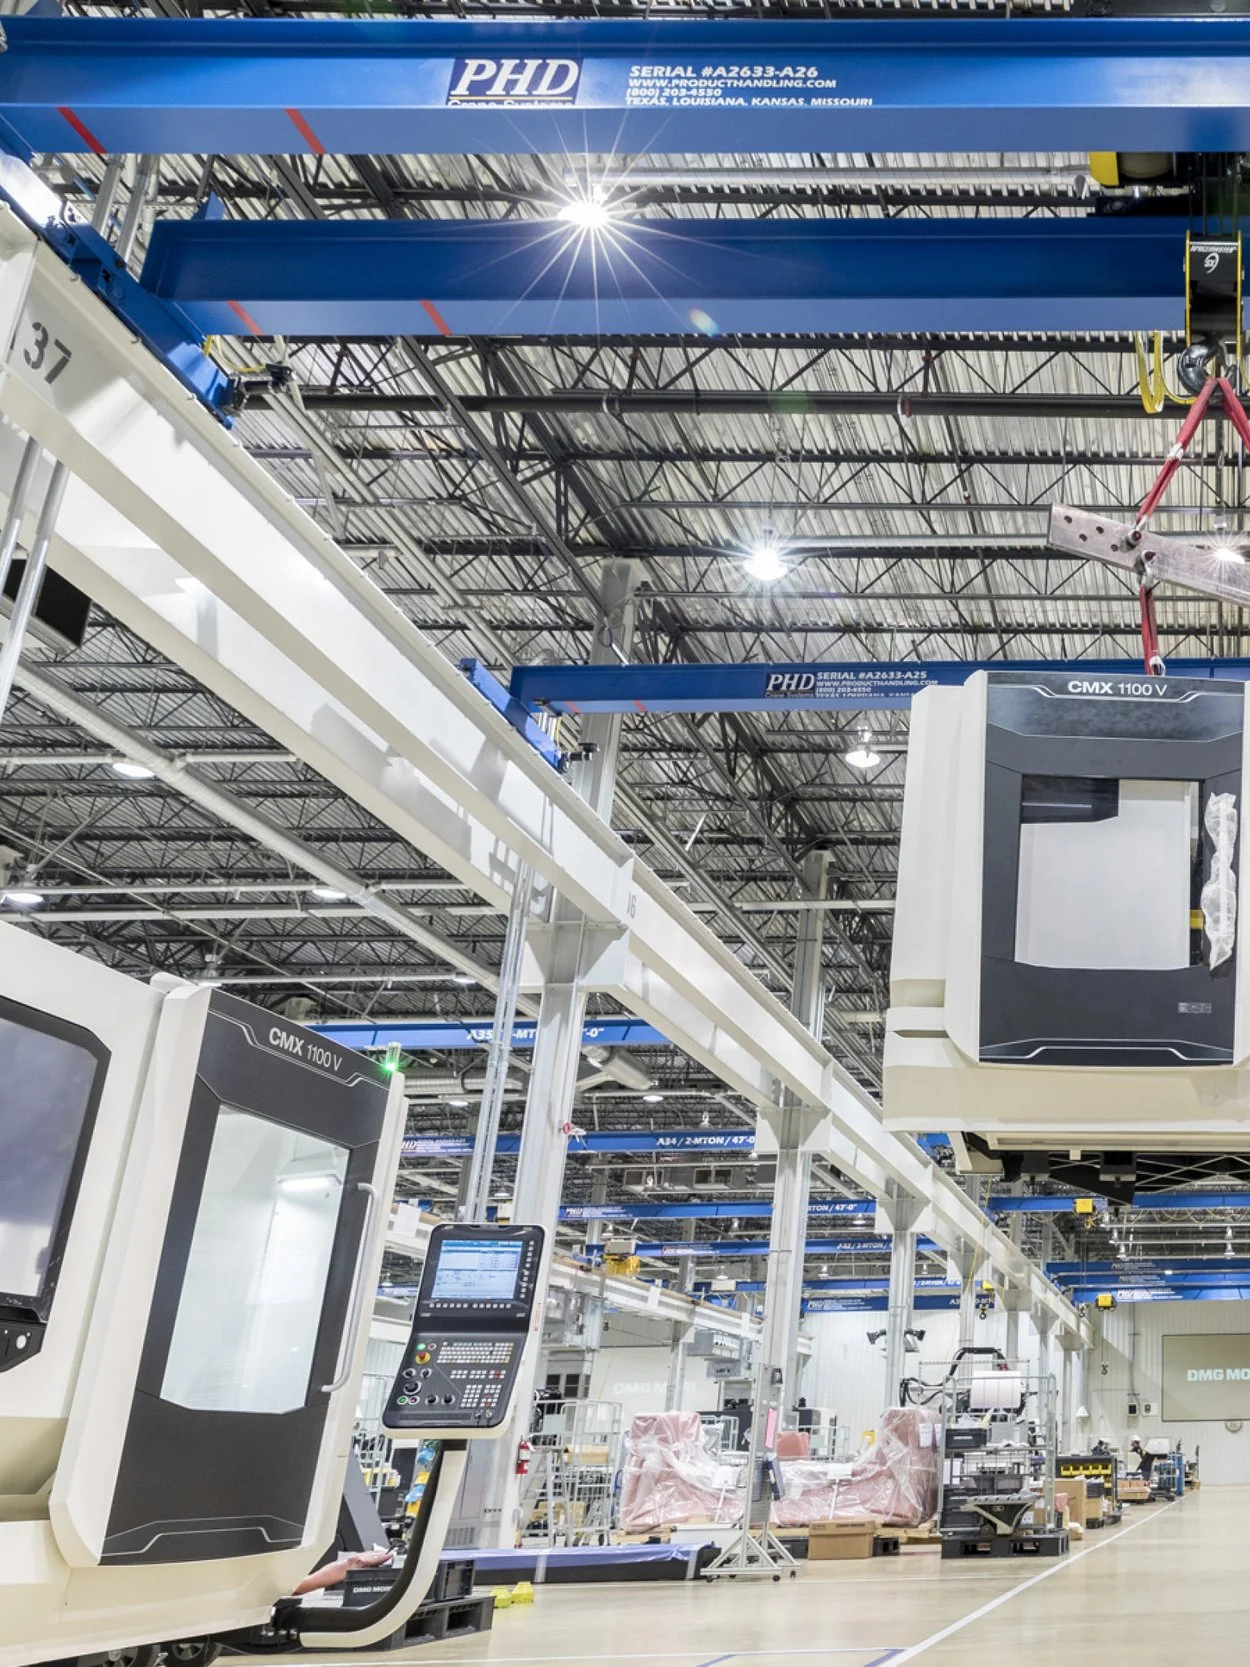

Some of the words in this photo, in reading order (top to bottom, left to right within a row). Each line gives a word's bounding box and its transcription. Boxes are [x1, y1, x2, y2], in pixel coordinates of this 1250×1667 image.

[450, 58, 580, 96] PHD
[629, 65, 697, 78] SERIAL
[701, 65, 819, 78] #A2633-A26
[628, 79, 837, 88] WWW.PRODUCTHANDLING.COM
[626, 88, 660, 98] (800)
[662, 88, 723, 97] 203-4550
[810, 97, 873, 107] MISSOURI
[24, 322, 72, 385] 37
[766, 673, 816, 691] PHD
[817, 671, 857, 680] SERIAL
[858, 671, 928, 680] #A2633-A25
[1067, 680, 1113, 694] CMX
[1118, 682, 1152, 696] 1100
[1154, 684, 1168, 696] V
[269, 1027, 304, 1056] CMX
[307, 1043, 331, 1068] 1100
[333, 1054, 343, 1071] V
[685, 1136, 723, 1145] 2-MTON
[1187, 1369, 1224, 1382] DMG
